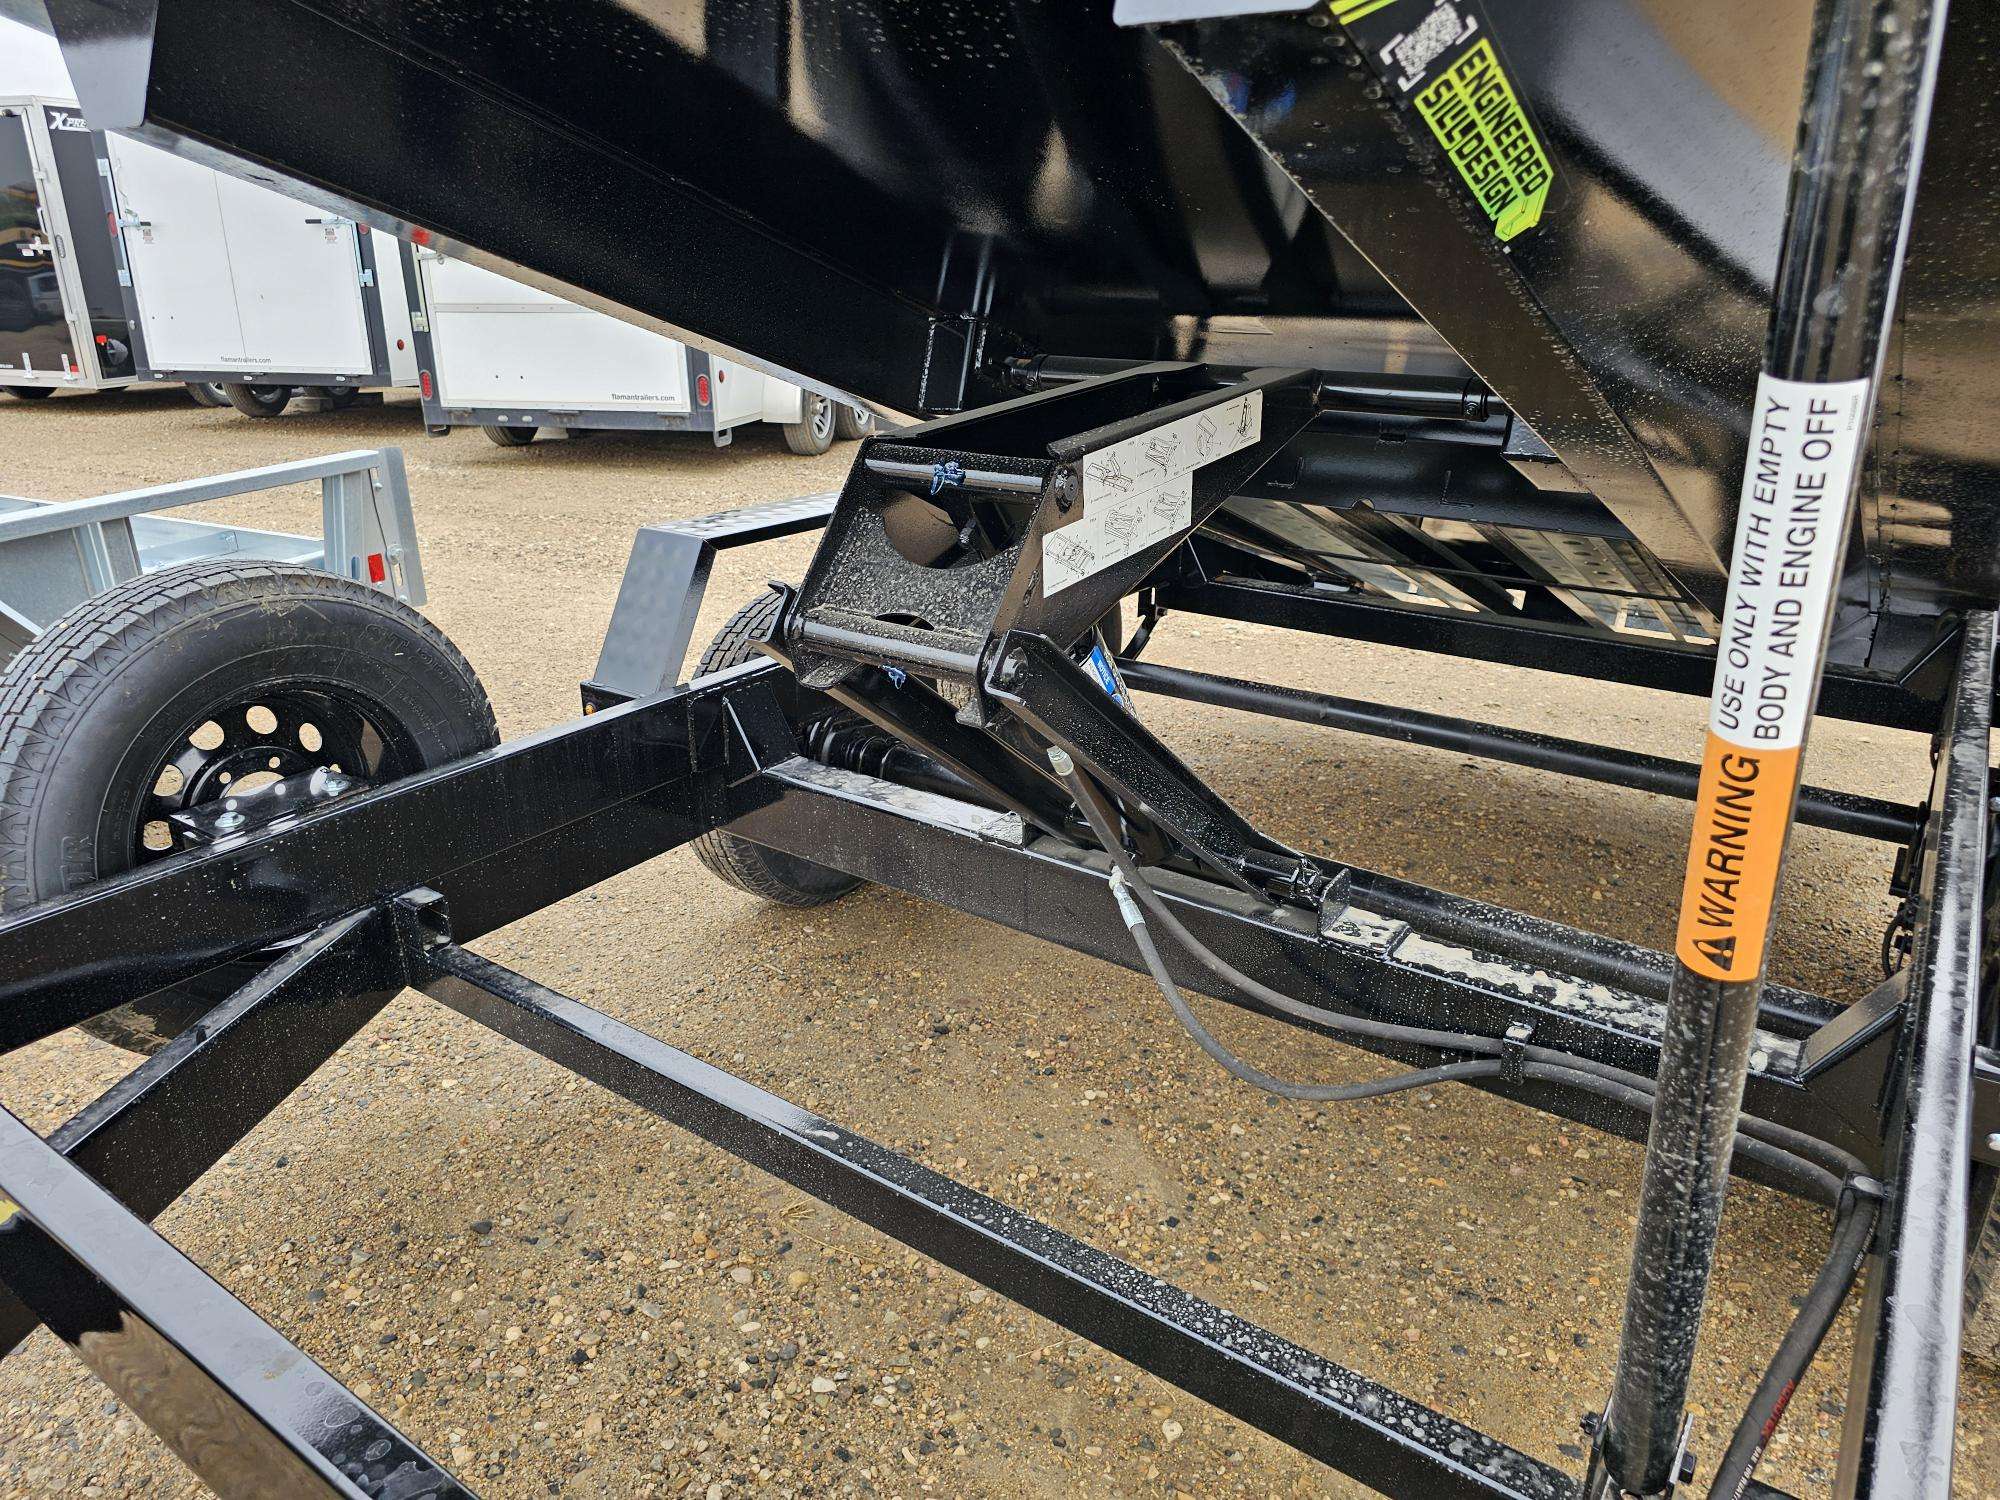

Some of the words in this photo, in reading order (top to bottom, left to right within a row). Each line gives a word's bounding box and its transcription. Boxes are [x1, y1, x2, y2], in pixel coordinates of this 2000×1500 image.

[1454, 47, 1548, 197] ENGINEERED
[611, 393, 676, 402] flamantrailers.com
[1801, 398, 1838, 462] OFF
[1753, 395, 1790, 505] EMPTY
[1740, 513, 1771, 586] WITH
[1778, 472, 1827, 587] ENGINE
[1728, 593, 1757, 669] ONLY
[1768, 599, 1802, 658] AND
[1718, 674, 1745, 730] USE
[1753, 666, 1790, 740] BODY
[1696, 753, 1761, 928] WARNING
